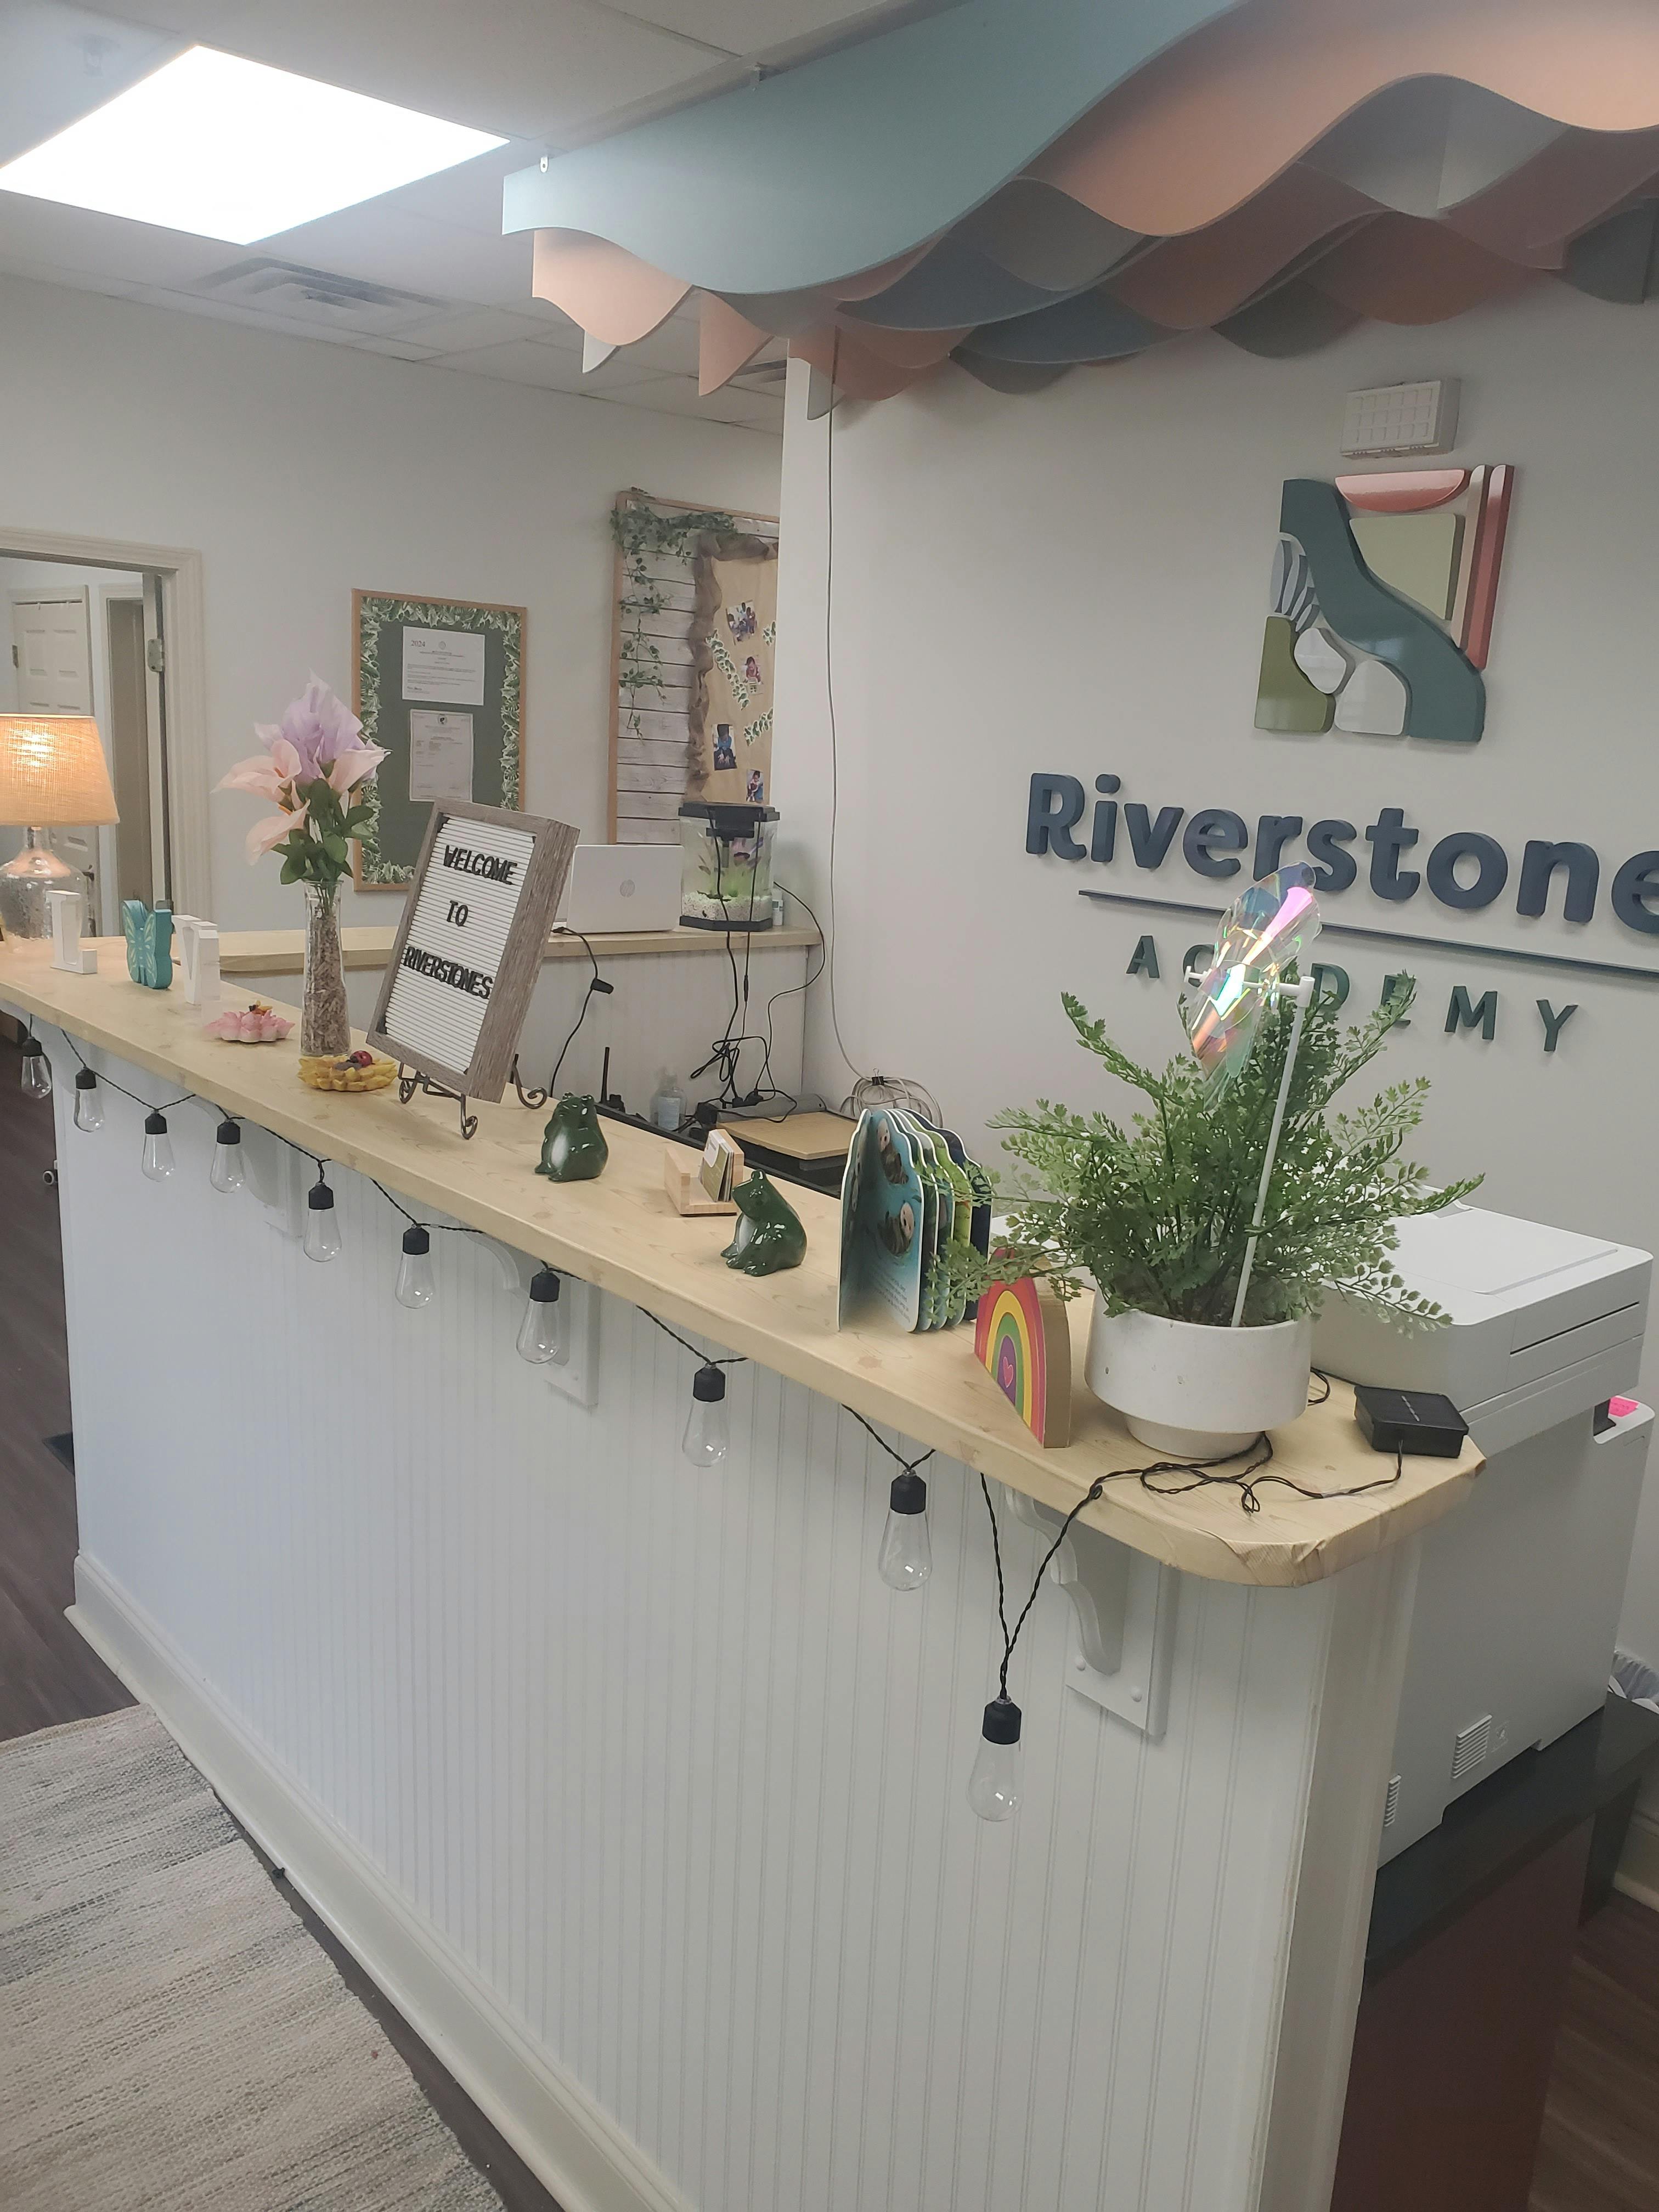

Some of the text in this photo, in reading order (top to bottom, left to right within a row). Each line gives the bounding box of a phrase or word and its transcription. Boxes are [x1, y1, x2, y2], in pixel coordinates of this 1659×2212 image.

[443, 845, 517, 885] WELCOME
[1025, 772, 1659, 934] Riverstone
[447, 900, 469, 927] TO
[404, 946, 494, 1000] RIVERSTONES
